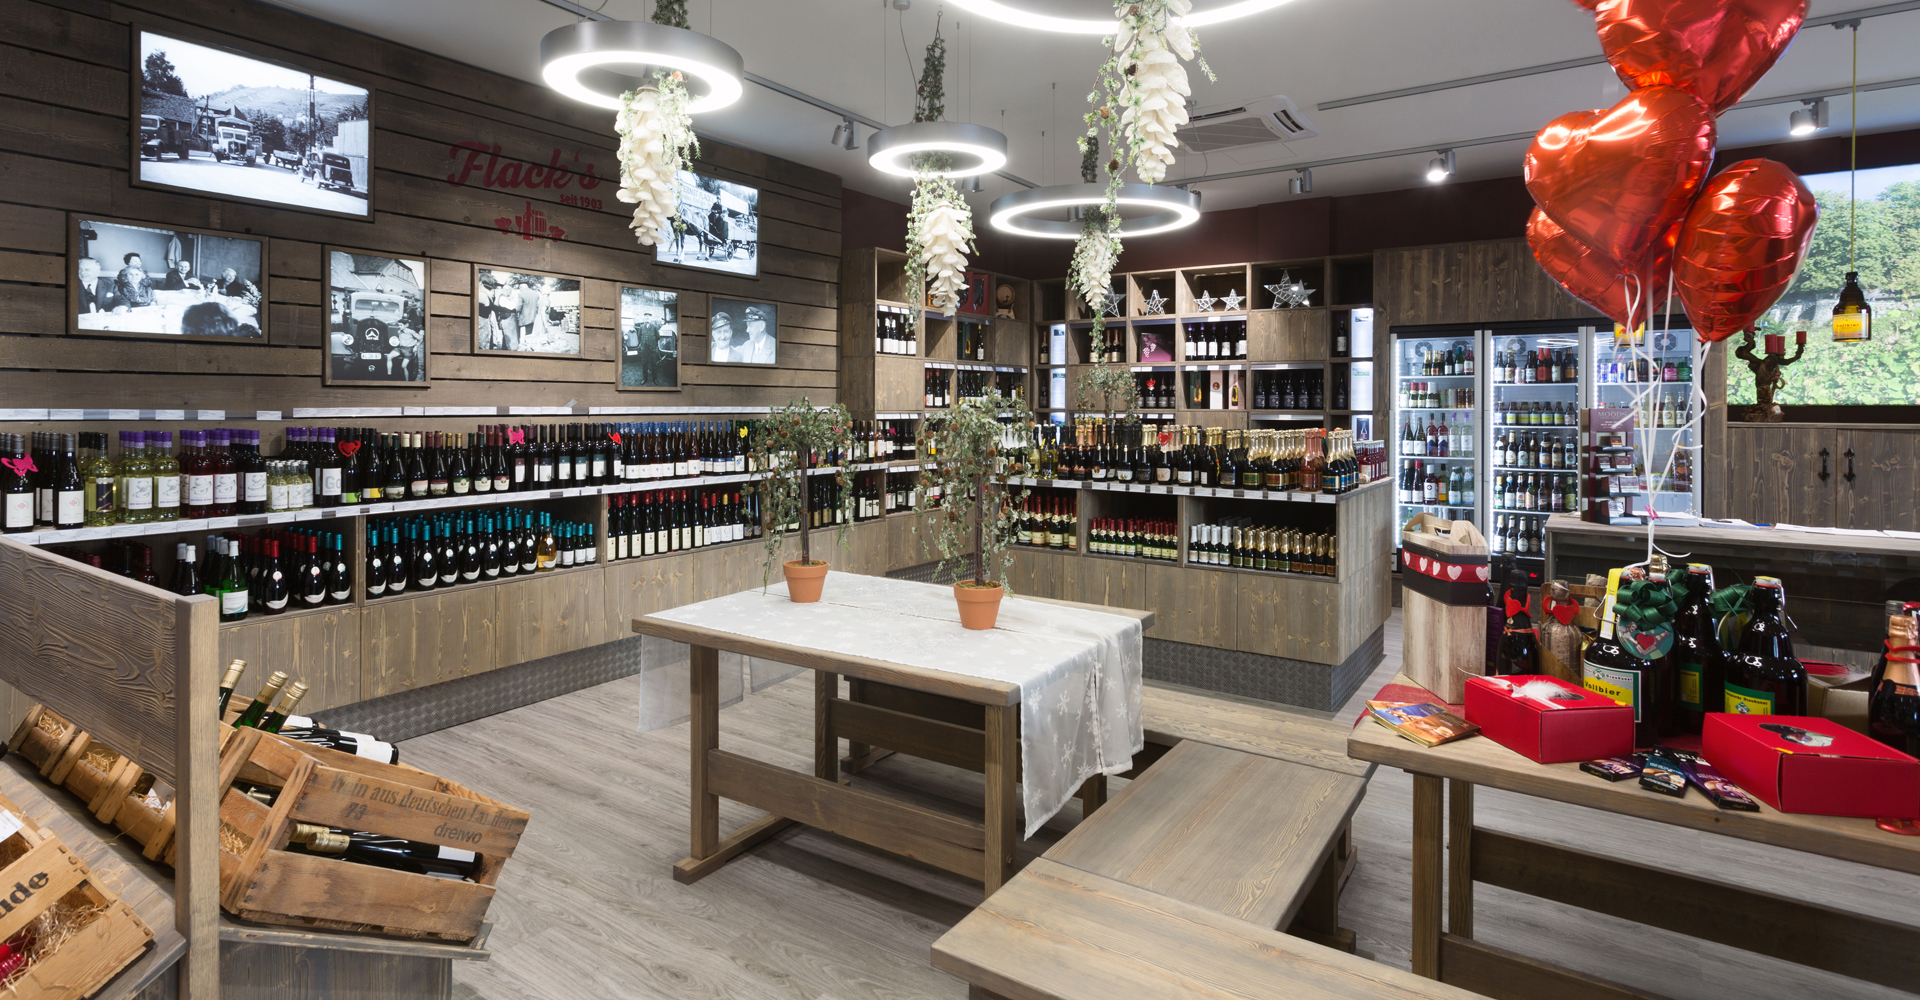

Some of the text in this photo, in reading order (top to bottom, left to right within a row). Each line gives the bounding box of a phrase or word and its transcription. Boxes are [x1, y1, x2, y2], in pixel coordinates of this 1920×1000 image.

[447, 141, 603, 190] Flack's
[560, 194, 603, 210] seit 1903
[1585, 680, 1621, 696] Vollbier
[330, 772, 369, 798] Win
[370, 787, 399, 804] aus
[400, 788, 467, 819] deutschen
[345, 802, 368, 820] 73
